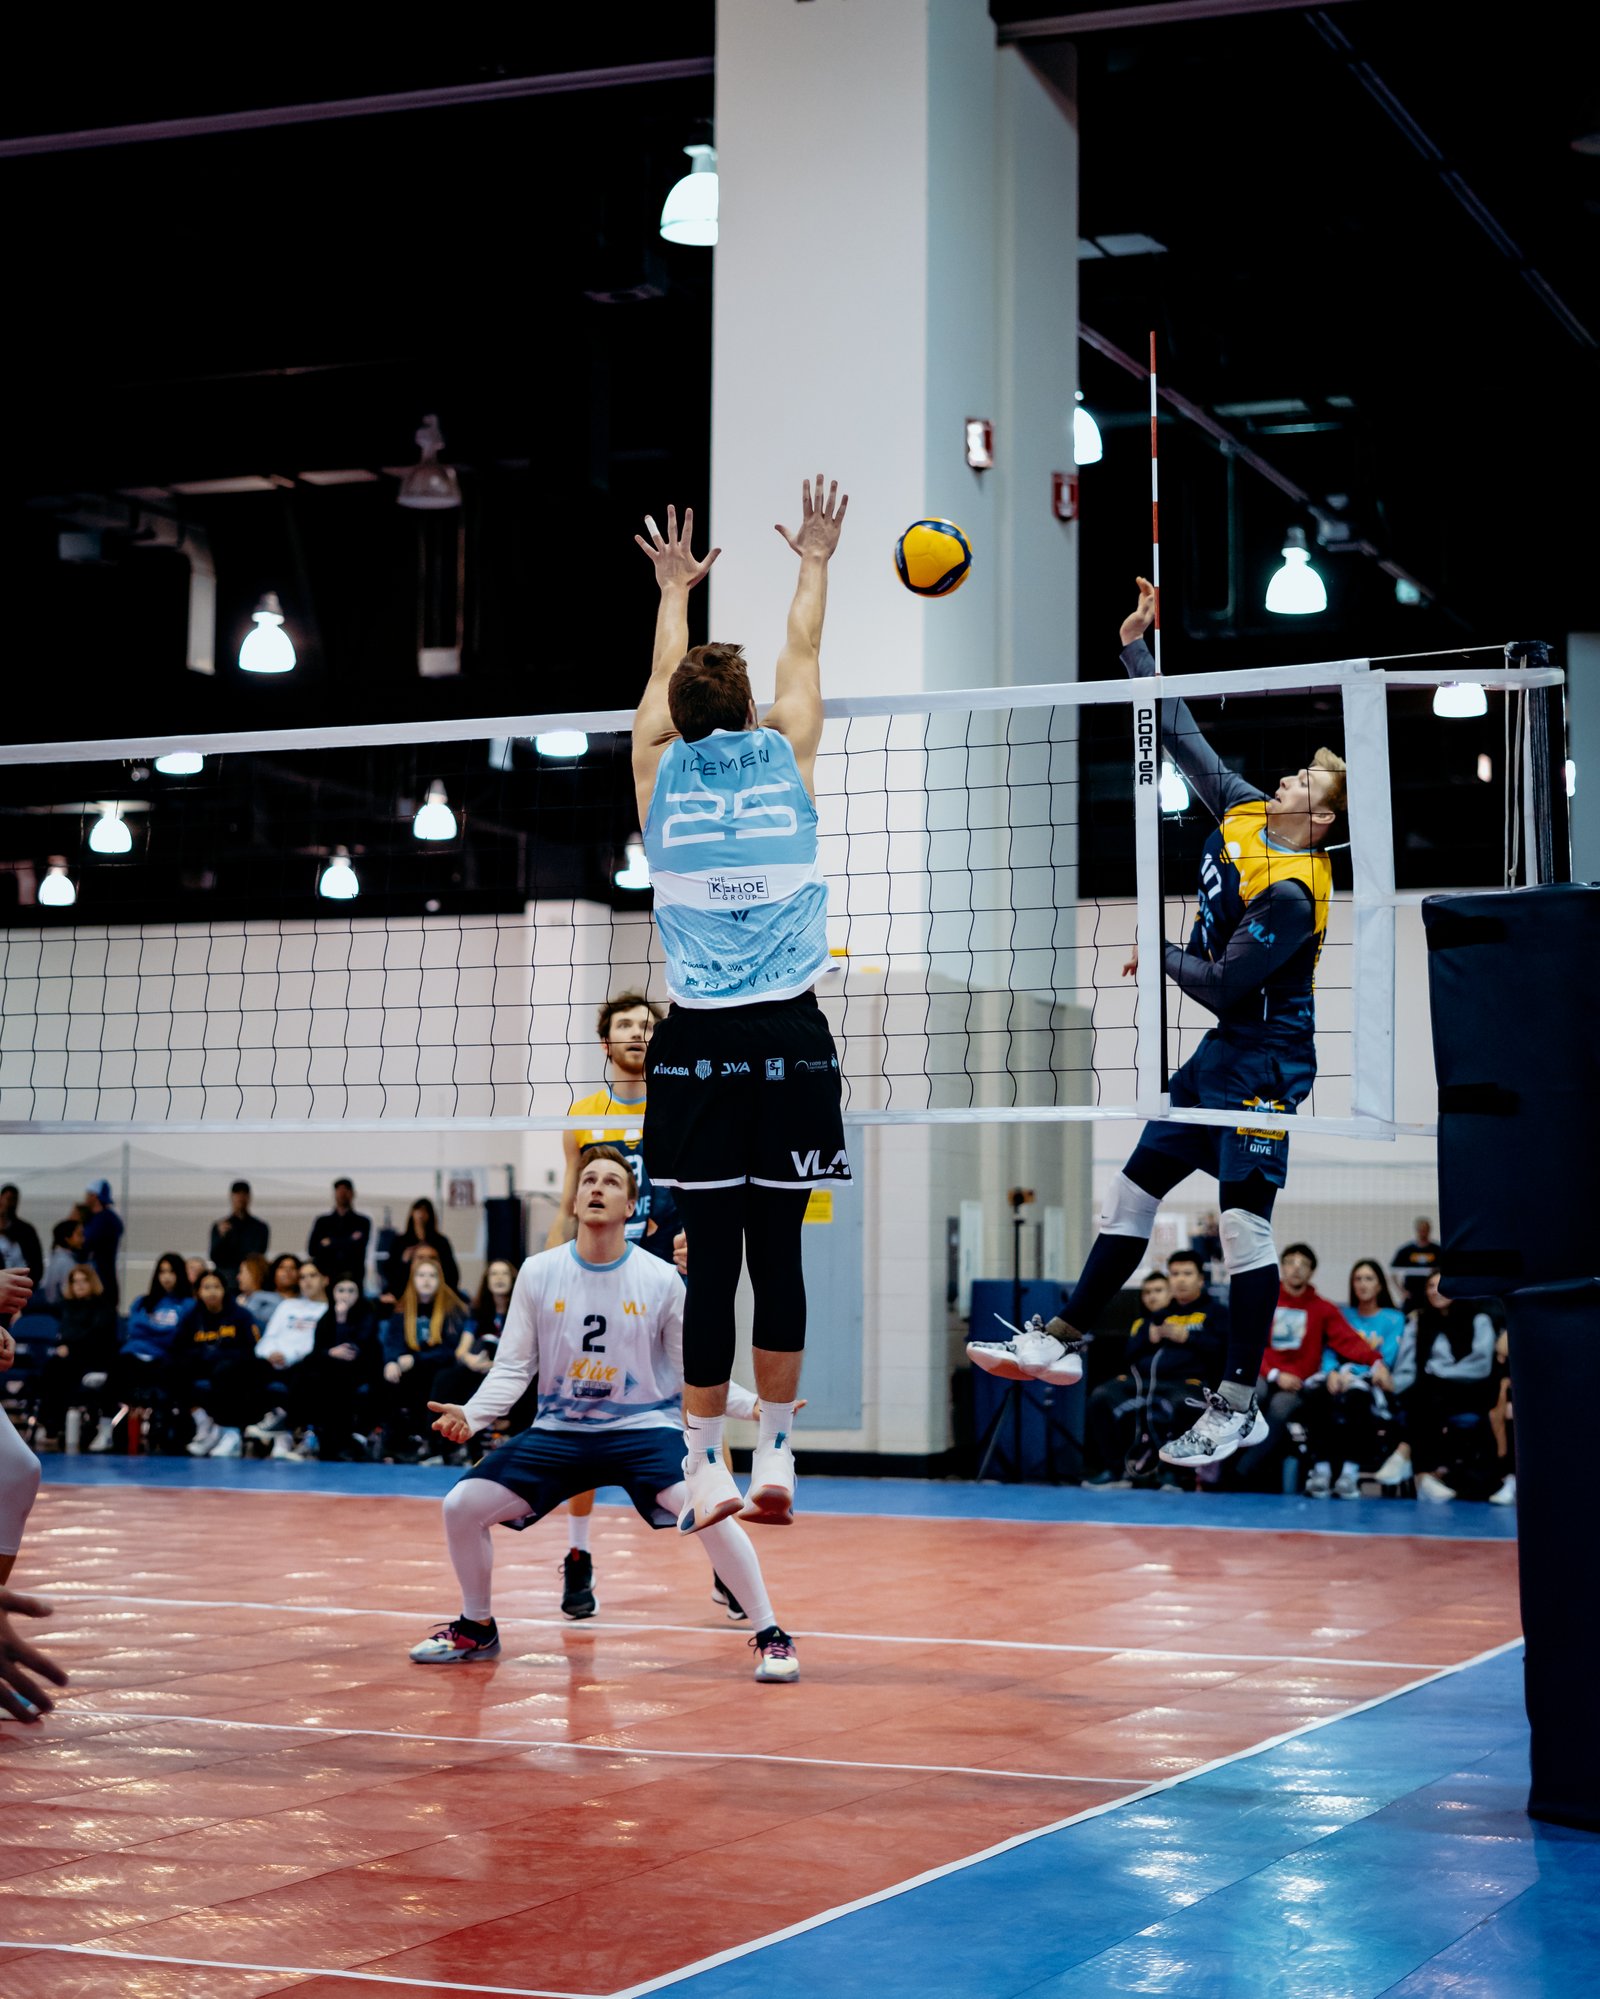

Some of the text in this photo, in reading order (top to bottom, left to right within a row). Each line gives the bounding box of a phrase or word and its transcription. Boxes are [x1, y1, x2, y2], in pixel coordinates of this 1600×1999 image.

[681, 749, 770, 776] ICEMEN
[662, 782, 798, 848] 25
[712, 881, 765, 893] KEHOE
[791, 1149, 849, 1177] VLA
[1249, 1143, 1272, 1156] DIVE
[582, 1314, 606, 1353] 2
